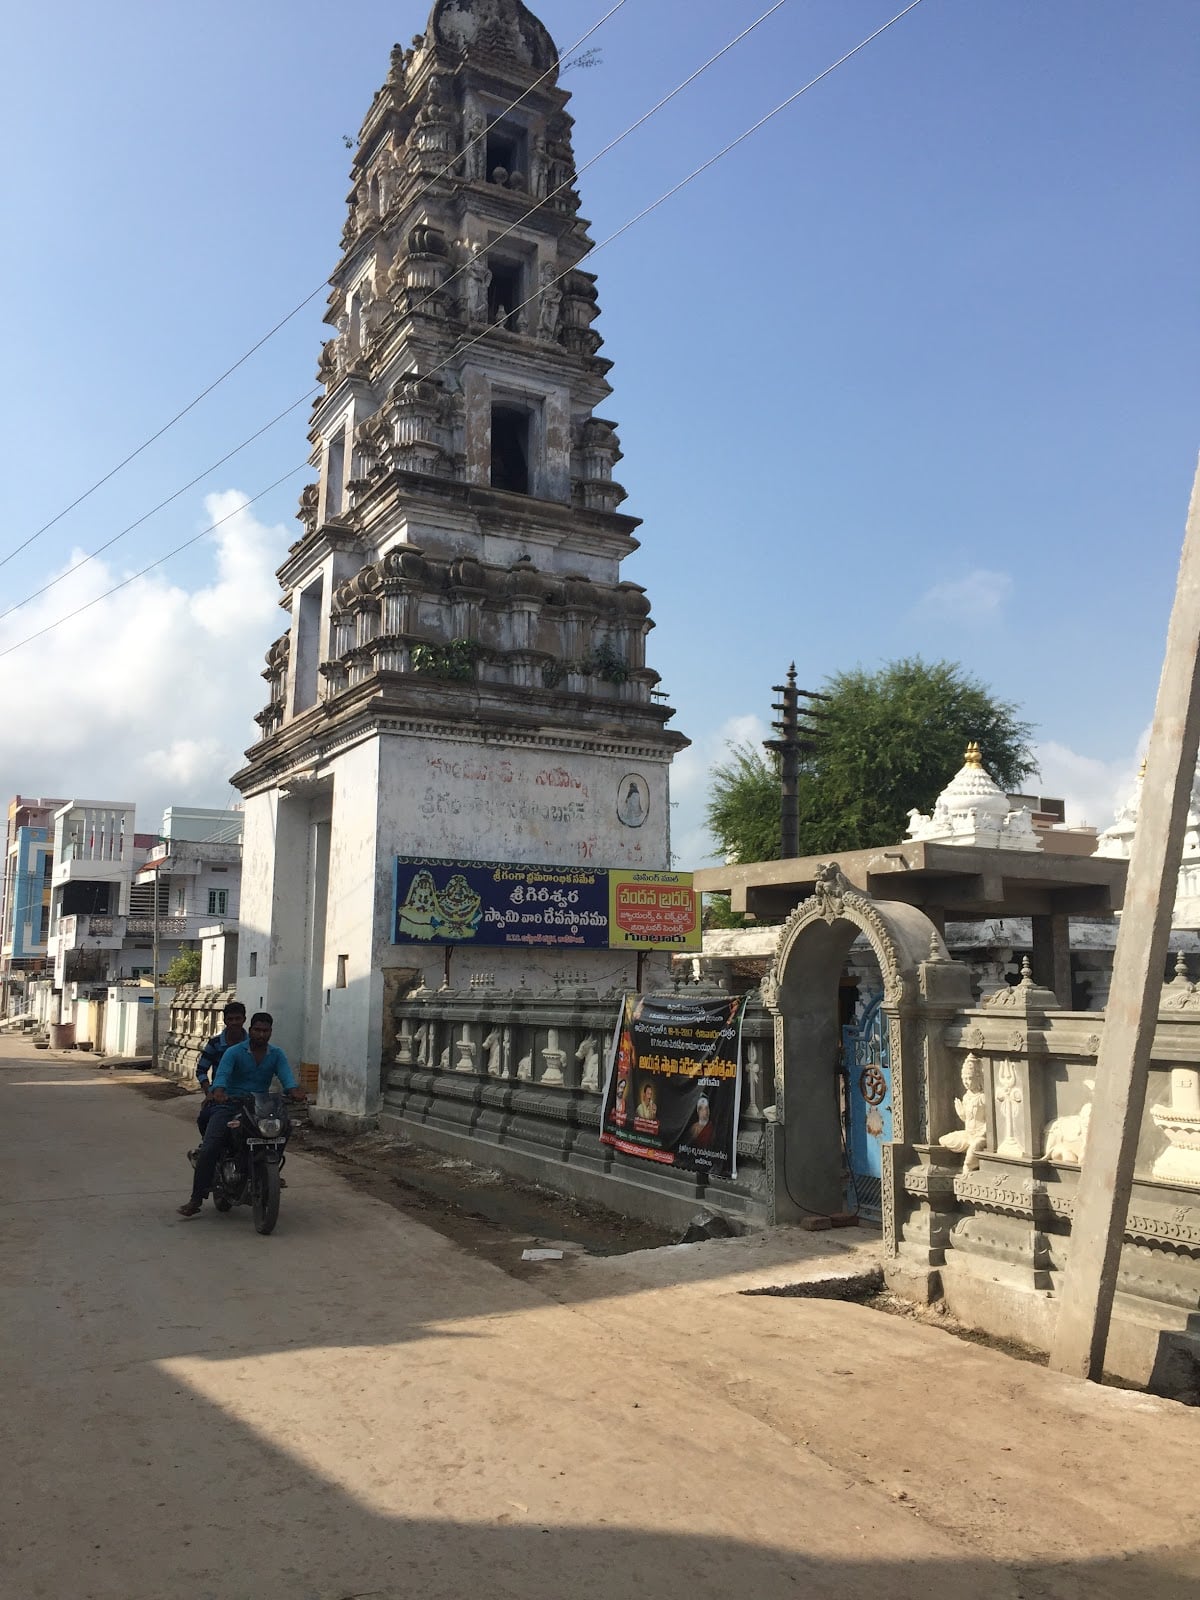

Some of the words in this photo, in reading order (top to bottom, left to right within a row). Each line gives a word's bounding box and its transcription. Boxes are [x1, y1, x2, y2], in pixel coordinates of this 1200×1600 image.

[510, 885, 524, 905] శ్రీ
[620, 888, 656, 905] చందన
[659, 890, 692, 912] బ్రదర్స్
[485, 907, 520, 928] స్వామి
[521, 912, 543, 924] వారి
[544, 907, 608, 935] దేవస్థానము
